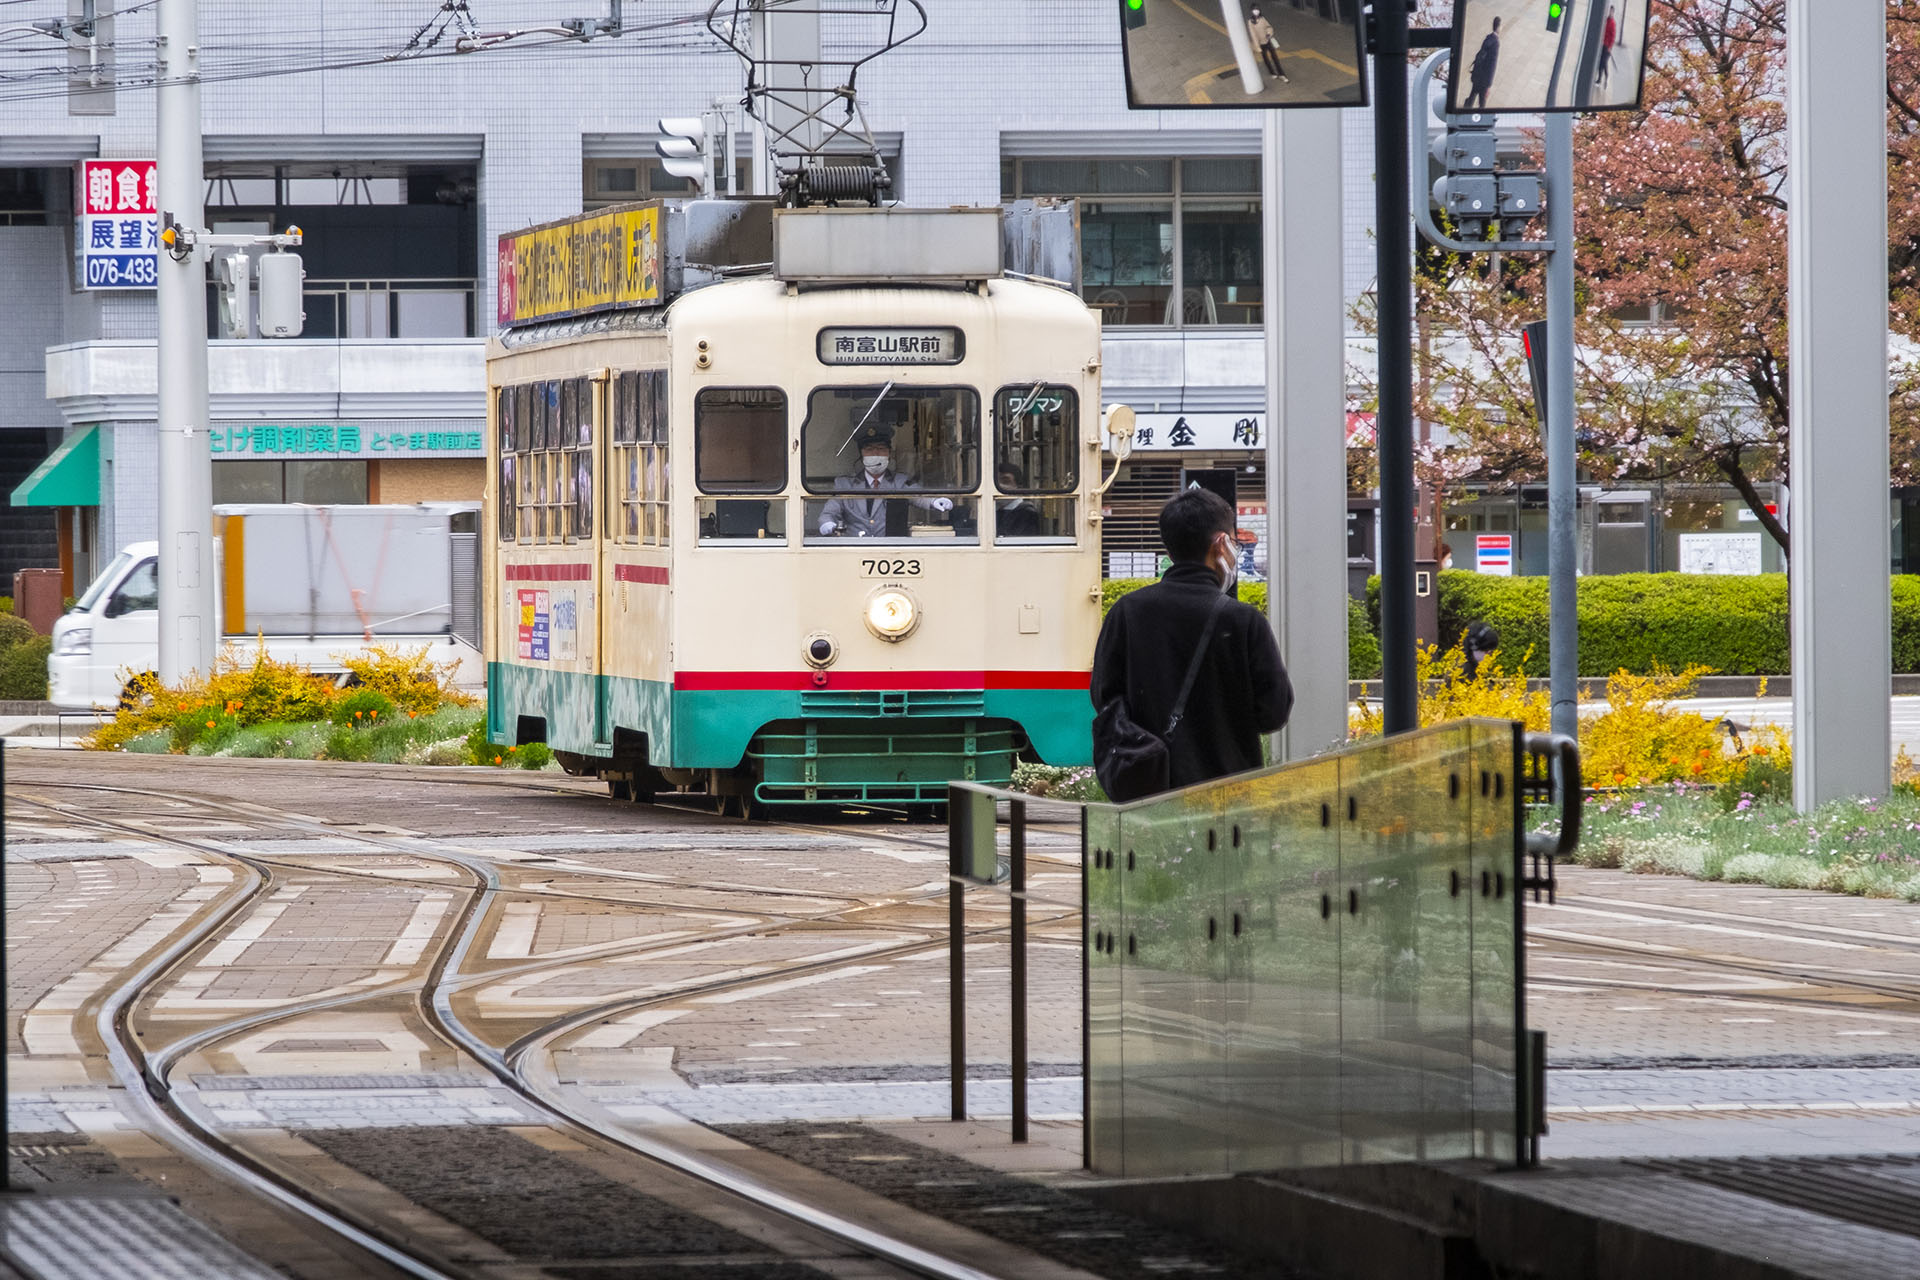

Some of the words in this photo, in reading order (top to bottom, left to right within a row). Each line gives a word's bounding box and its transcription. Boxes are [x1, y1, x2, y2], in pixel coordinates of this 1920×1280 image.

[835, 336, 941, 353] 南富山駅前
[370, 431, 482, 451] とやま駅前店
[861, 559, 921, 575] 7023
